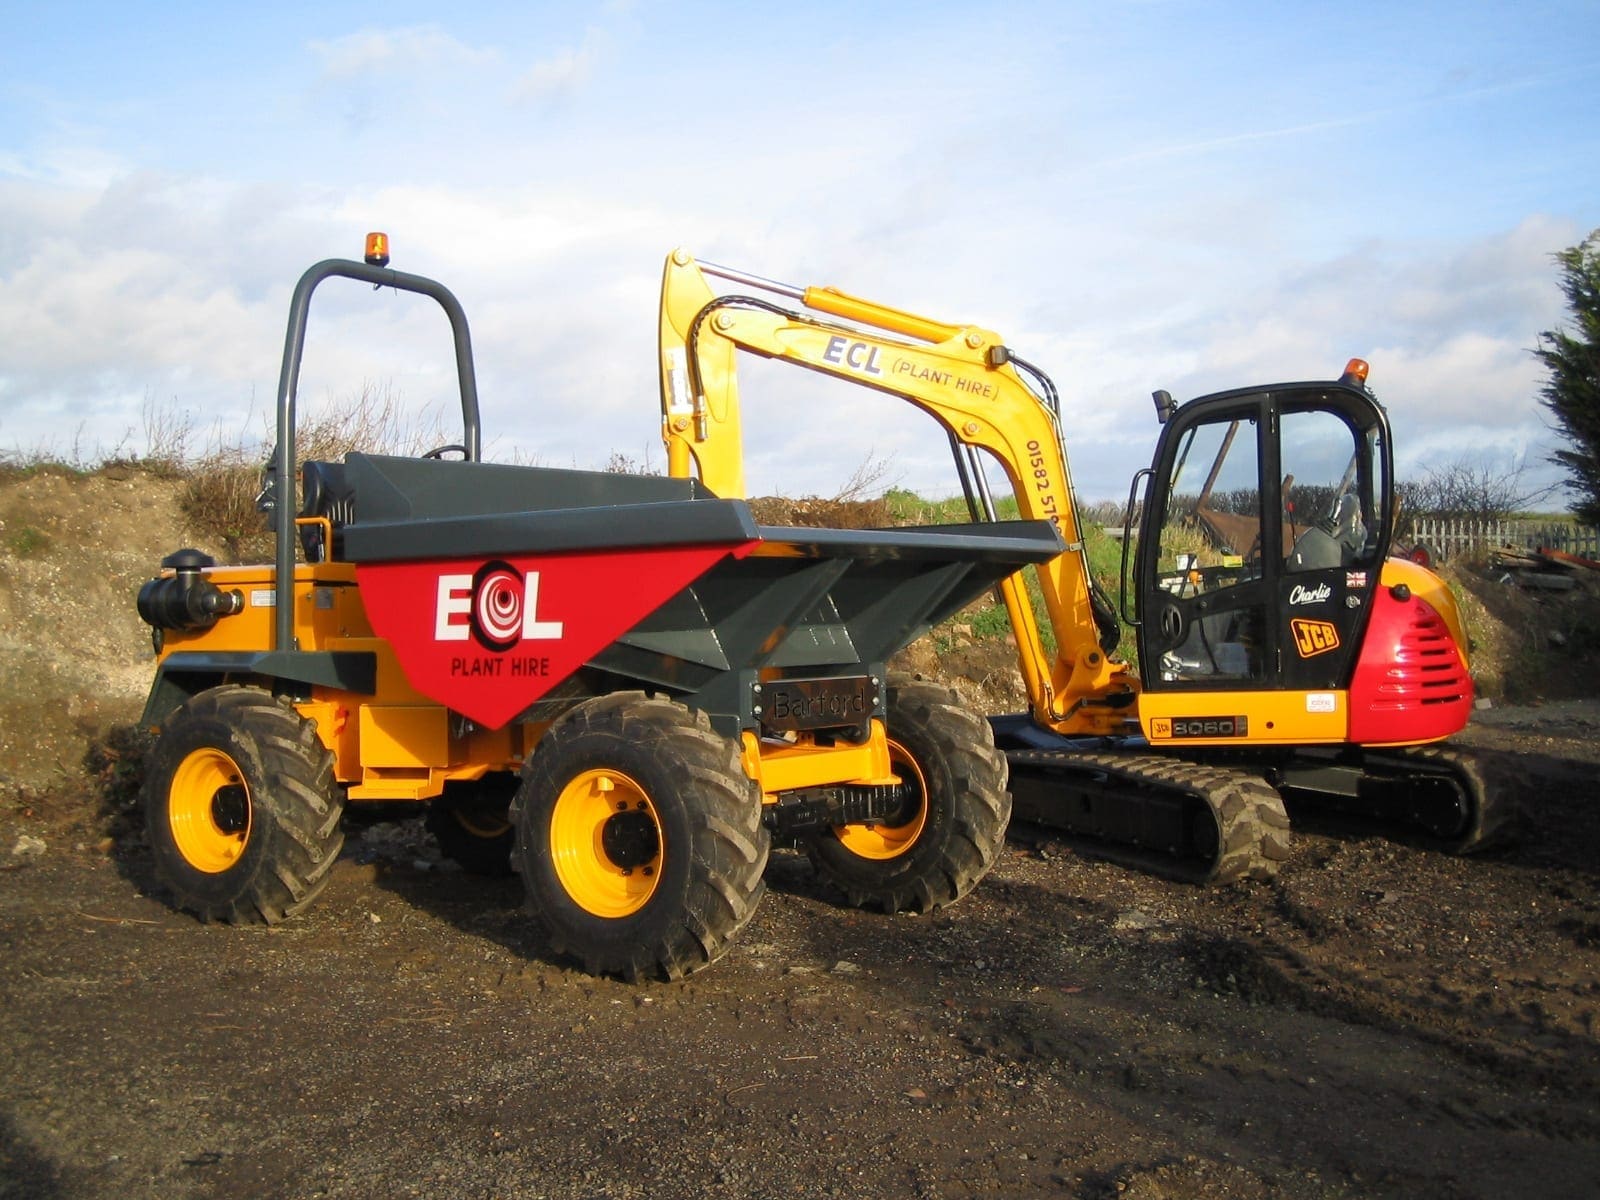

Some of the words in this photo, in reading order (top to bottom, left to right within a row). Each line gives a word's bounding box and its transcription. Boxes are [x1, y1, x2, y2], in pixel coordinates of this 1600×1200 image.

[823, 335, 881, 375] ECL
[1026, 440, 1050, 492] 01582
[1289, 582, 1332, 605] Charlie
[1298, 622, 1336, 654] JCB
[451, 658, 504, 677] PLANT
[511, 657, 550, 677] HIRE
[774, 687, 865, 719] Barford
